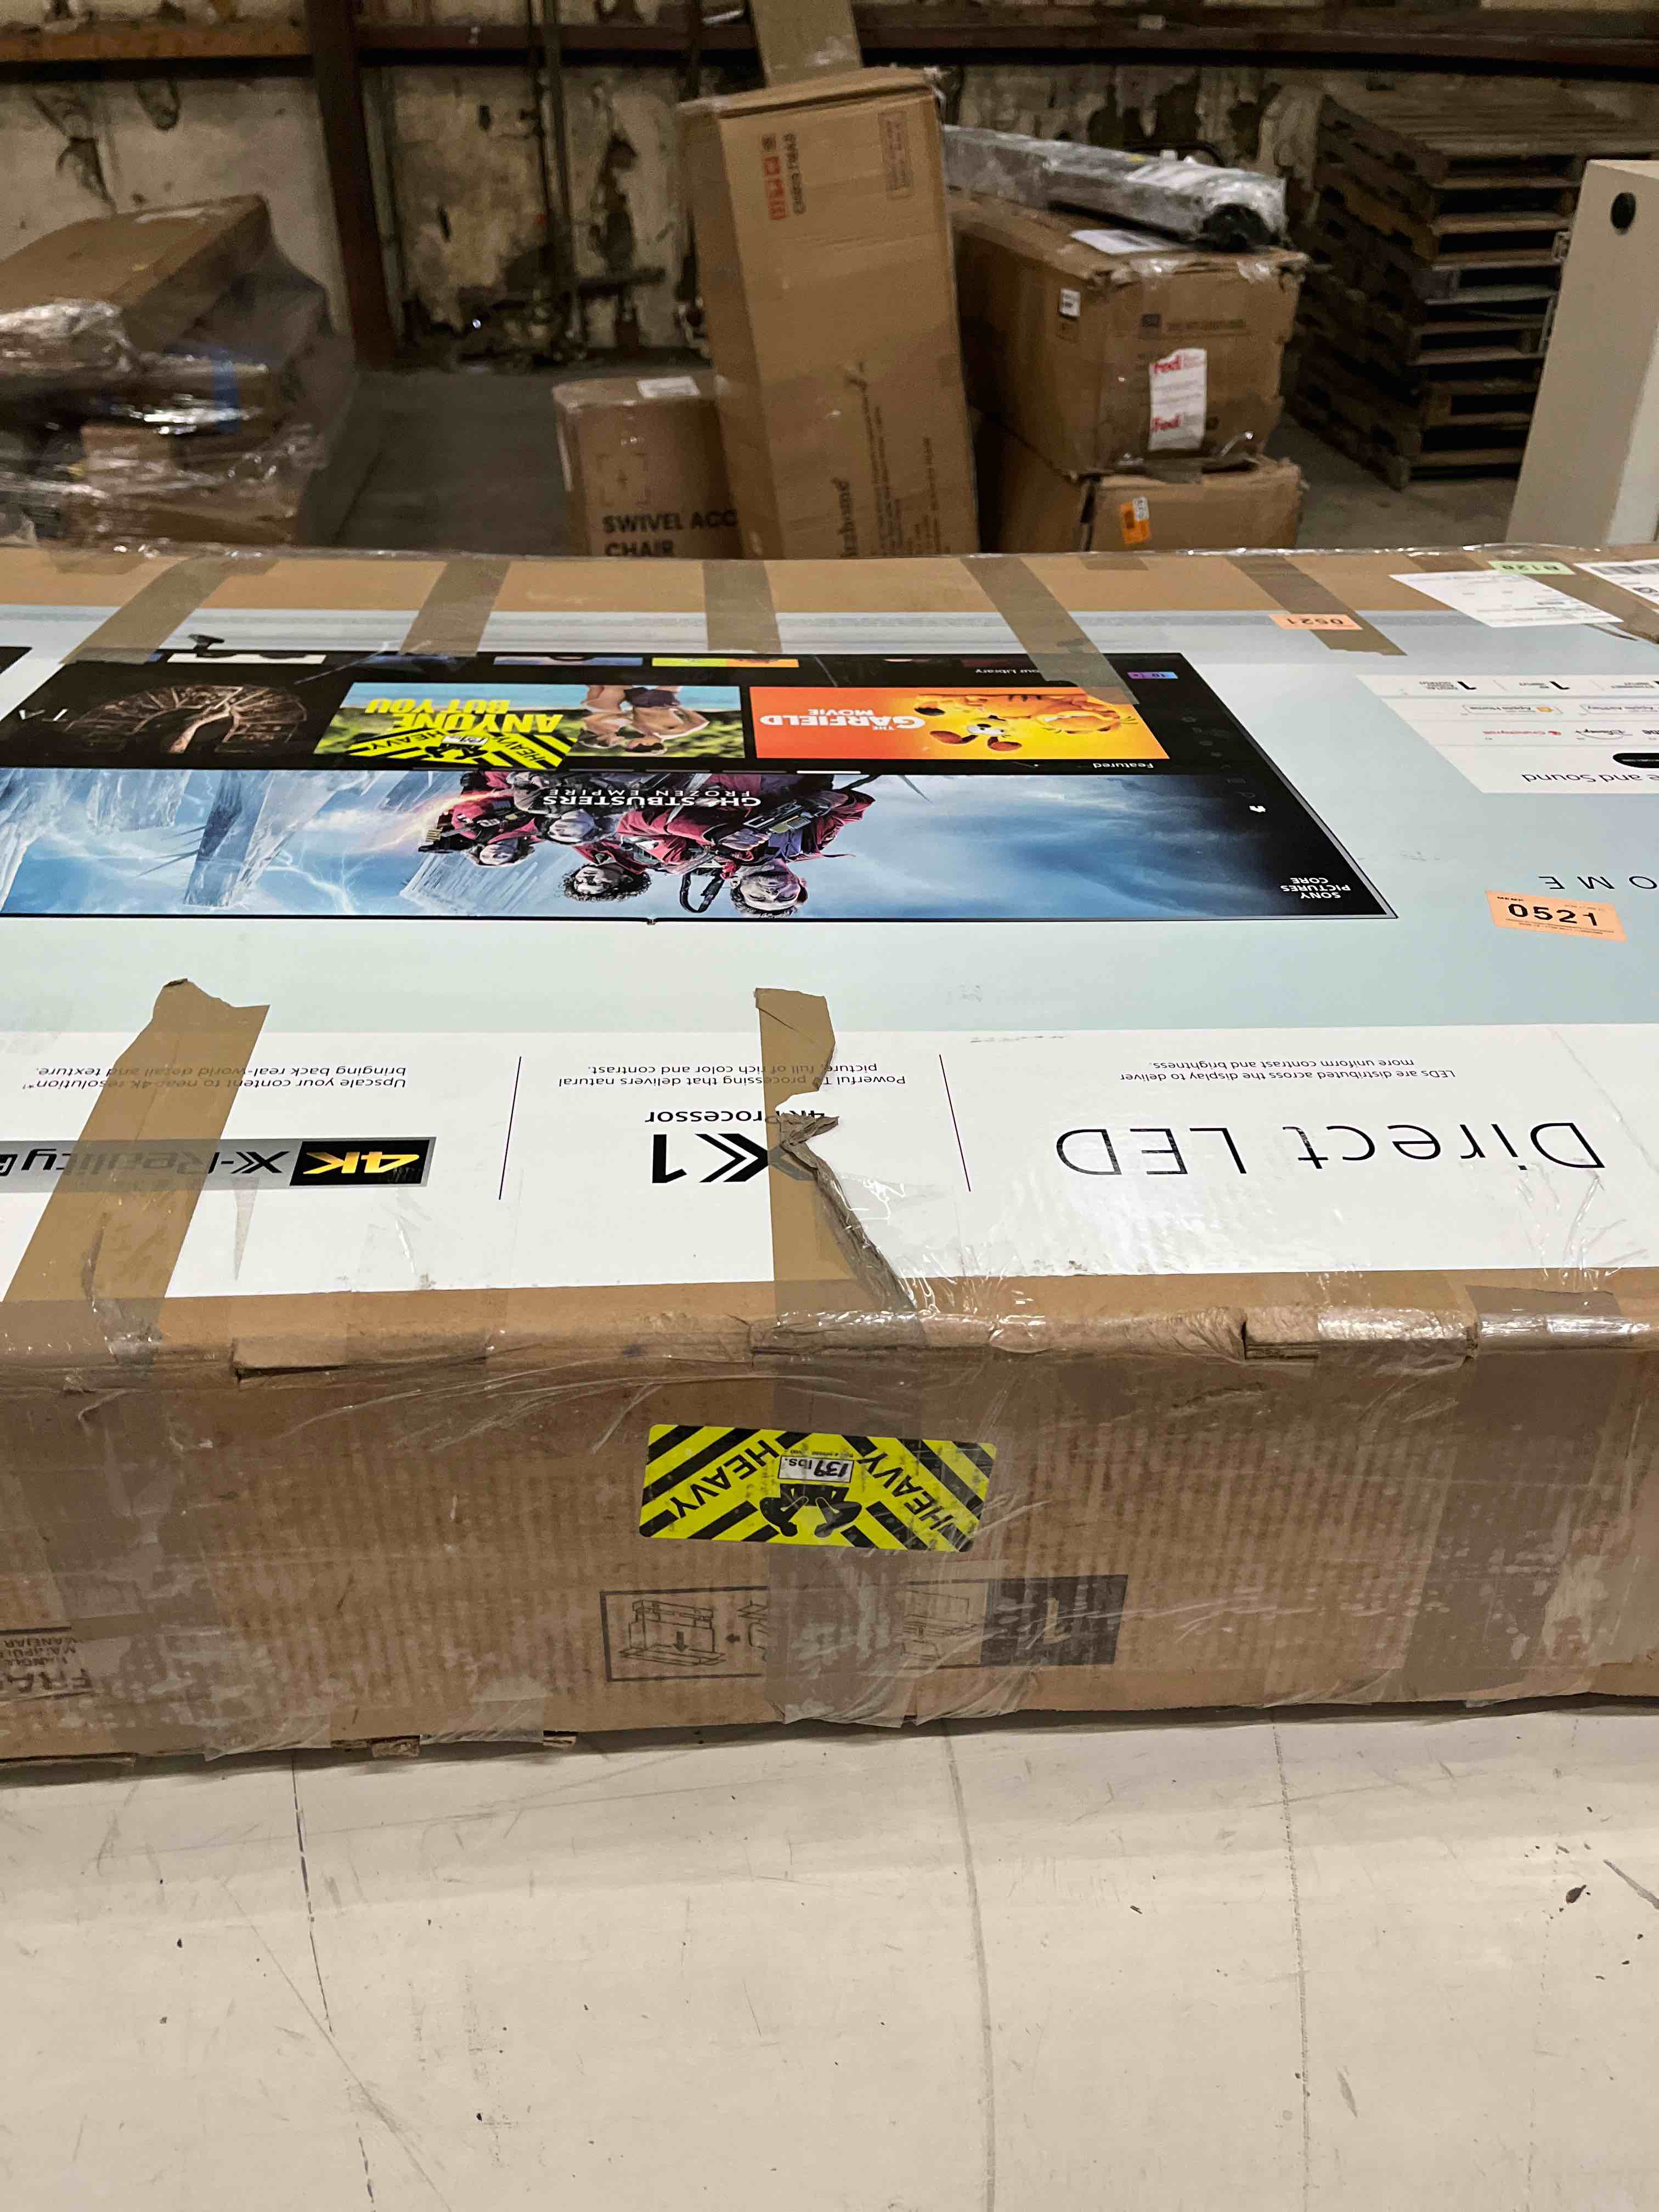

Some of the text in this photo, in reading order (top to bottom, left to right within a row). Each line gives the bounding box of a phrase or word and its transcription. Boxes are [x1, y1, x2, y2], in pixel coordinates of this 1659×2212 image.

[603, 512, 682, 533] SWIVEL
[364, 698, 509, 714] BUT YOU
[392, 713, 564, 733] ANYONE
[759, 715, 926, 729] GARFIELD
[371, 730, 446, 750] HEAVY
[494, 736, 544, 762] HEAVY
[1521, 775, 1596, 783] Sound
[1599, 775, 1643, 783] and
[1508, 903, 1599, 927] 0521
[1149, 1061, 1228, 1070] brightness.
[1320, 1060, 1374, 1068] uniform
[35, 1067, 102, 1076] texture.
[196, 1068, 286, 1076] real-world
[291, 1068, 330, 1076] back
[335, 1065, 407, 1076] bringing
[588, 1066, 656, 1075] contrast.
[661, 1066, 691, 1075] and
[738, 1066, 769, 1074] rich
[791, 1065, 815, 1074] full
[1120, 1073, 1167, 1081] deliver
[1189, 1071, 1239, 1081] display
[1316, 1071, 1392, 1080] distributed
[1421, 1070, 1456, 1079] LEDs
[202, 1080, 220, 1088] to
[228, 1080, 291, 1088] content
[297, 1079, 335, 1087] your
[340, 1078, 407, 1088] Upscale
[558, 1078, 615, 1087] natural
[619, 1078, 681, 1087] delivers
[686, 1077, 718, 1086] that
[722, 1076, 806, 1086] processing
[836, 1076, 905, 1085] Powerful
[645, 1110, 780, 1123] rocessor
[1055, 1122, 1606, 1175] Direct LED
[302, 1150, 421, 1175] 4K
[785, 1458, 812, 1470] lbs.
[813, 1460, 849, 1478] 139
[668, 1439, 780, 1519] HEAVY
[855, 1453, 955, 1530] HEAVY
